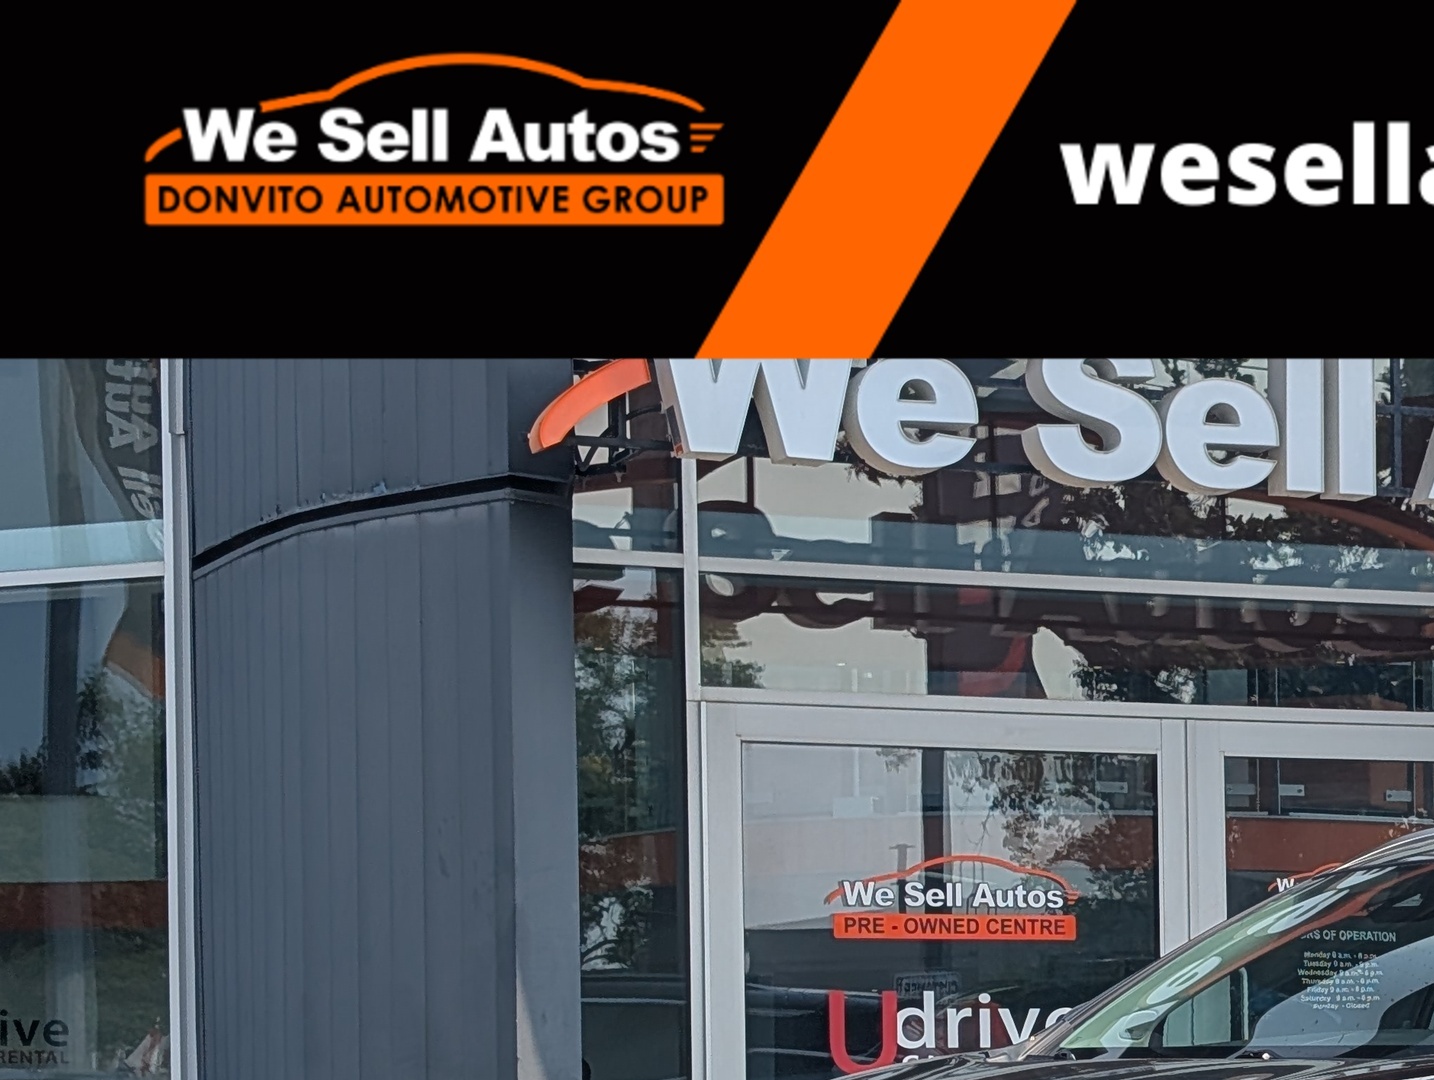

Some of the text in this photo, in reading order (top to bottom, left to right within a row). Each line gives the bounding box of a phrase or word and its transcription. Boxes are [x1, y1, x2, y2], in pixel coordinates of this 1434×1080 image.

[657, 358, 979, 476] We
[1021, 358, 1376, 501] Sell
[842, 880, 1065, 909] We Sell Autos
[844, 917, 885, 934] PRE
[904, 918, 980, 935] OWNED
[986, 918, 1066, 935] CENTRE
[1322, 930, 1337, 941] OF
[1338, 930, 1397, 942] OPERATION
